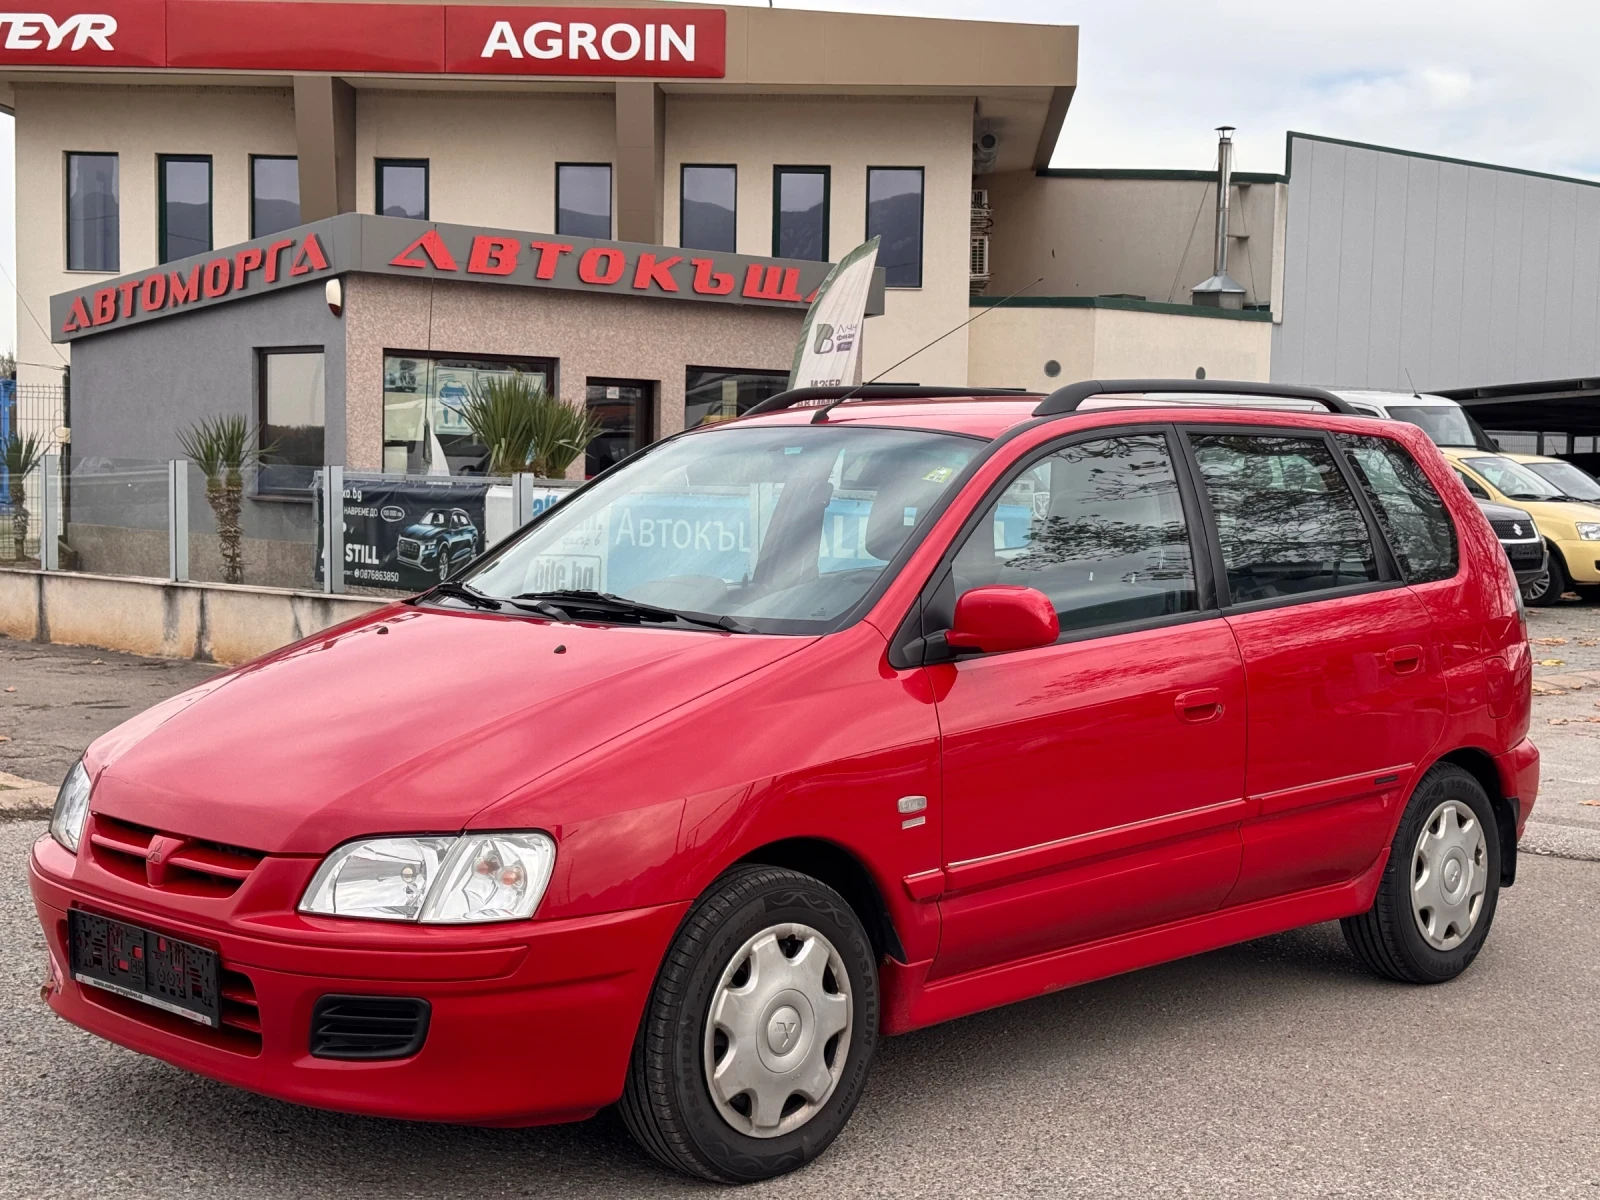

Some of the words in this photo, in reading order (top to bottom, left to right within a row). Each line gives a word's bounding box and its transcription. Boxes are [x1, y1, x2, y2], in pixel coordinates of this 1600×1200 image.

[481, 21, 696, 62] AGROIN
[61, 232, 329, 333] АВТОМОРГА
[344, 543, 380, 565] STILL
[858, 959, 877, 1048] SAILUN
